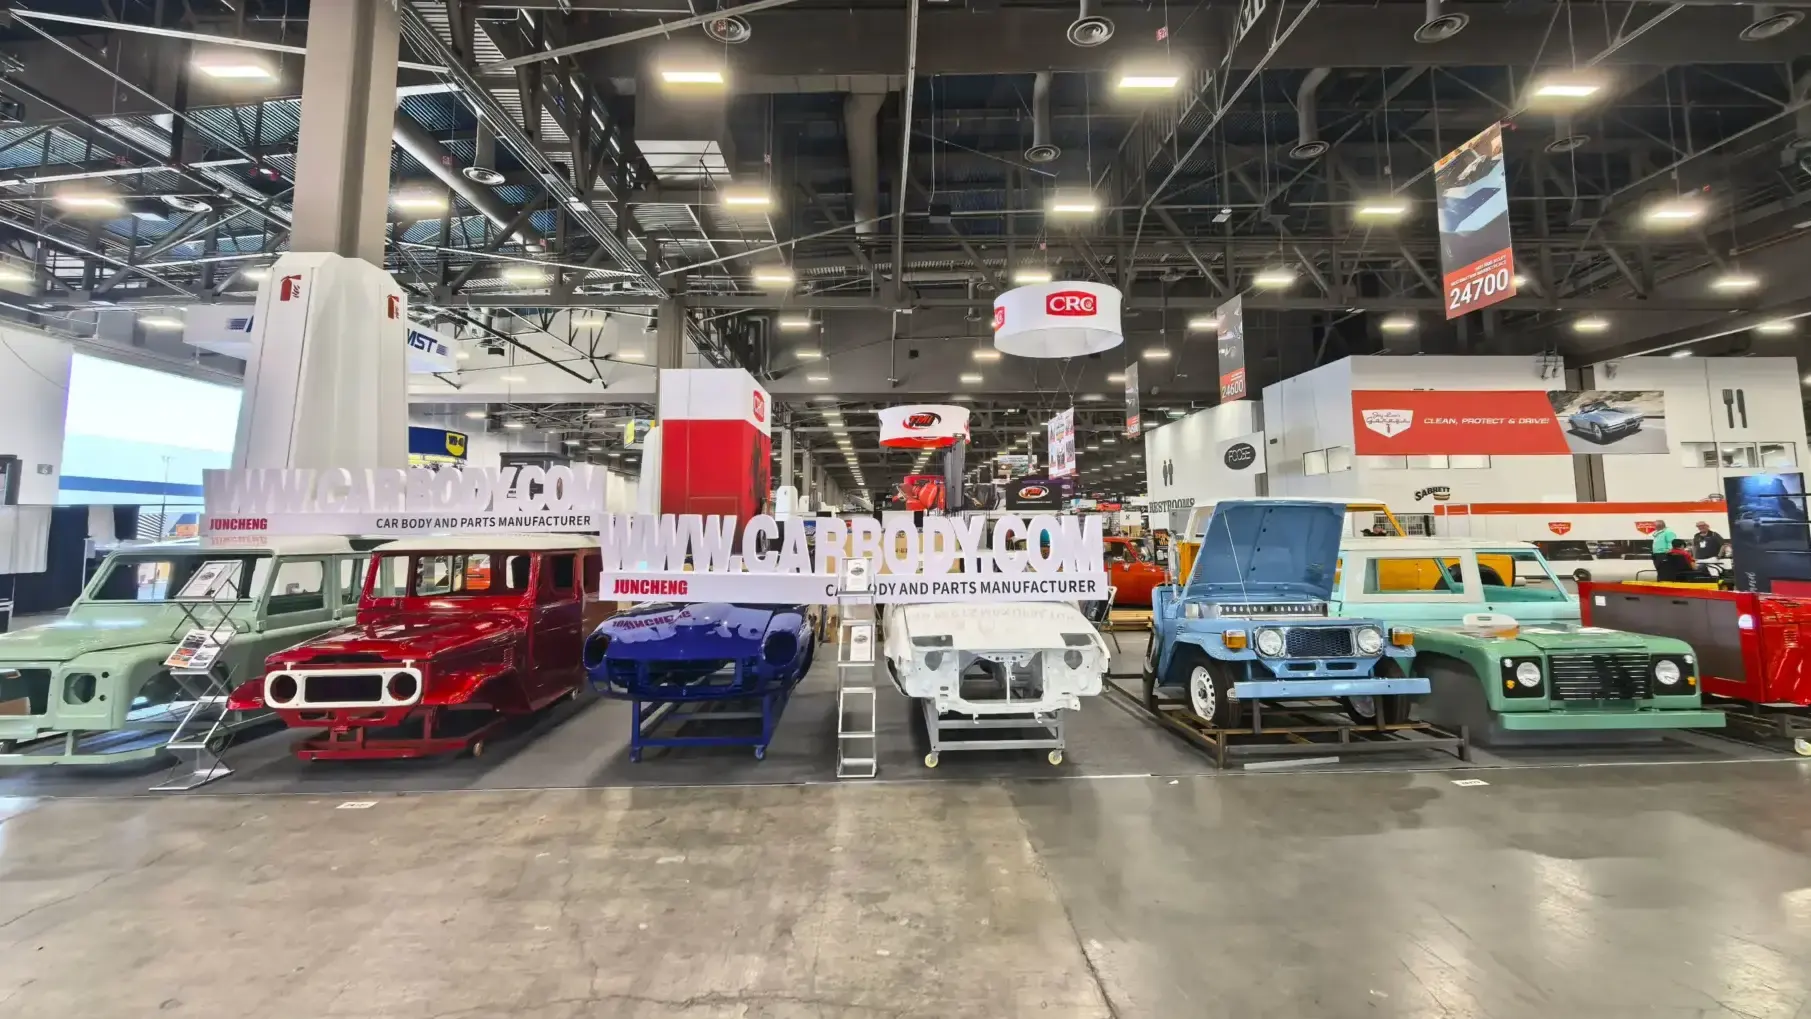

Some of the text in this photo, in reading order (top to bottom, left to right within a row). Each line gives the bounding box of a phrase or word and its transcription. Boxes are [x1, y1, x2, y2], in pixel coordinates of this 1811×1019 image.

[1449, 268, 1509, 310] 24700
[1049, 295, 1094, 312] CRC
[1221, 378, 1244, 399] 24600
[1423, 417, 1550, 425] CLEAN, PROTECT & DRIVE!
[1414, 486, 1451, 501] SABRETT
[1149, 498, 1195, 514] RESTROOMS
[209, 518, 268, 531] JUNCHENG
[376, 516, 591, 529] CAR BODY AND PARTS MANUFACTURER
[599, 513, 1104, 575] WWW.CARBODY.COM
[613, 579, 688, 595] JUNCHENG
[867, 582, 896, 596] ODY
[899, 582, 929, 595] AND
[932, 581, 977, 595] PARTS
[980, 579, 1096, 594] MANUFACTURER
